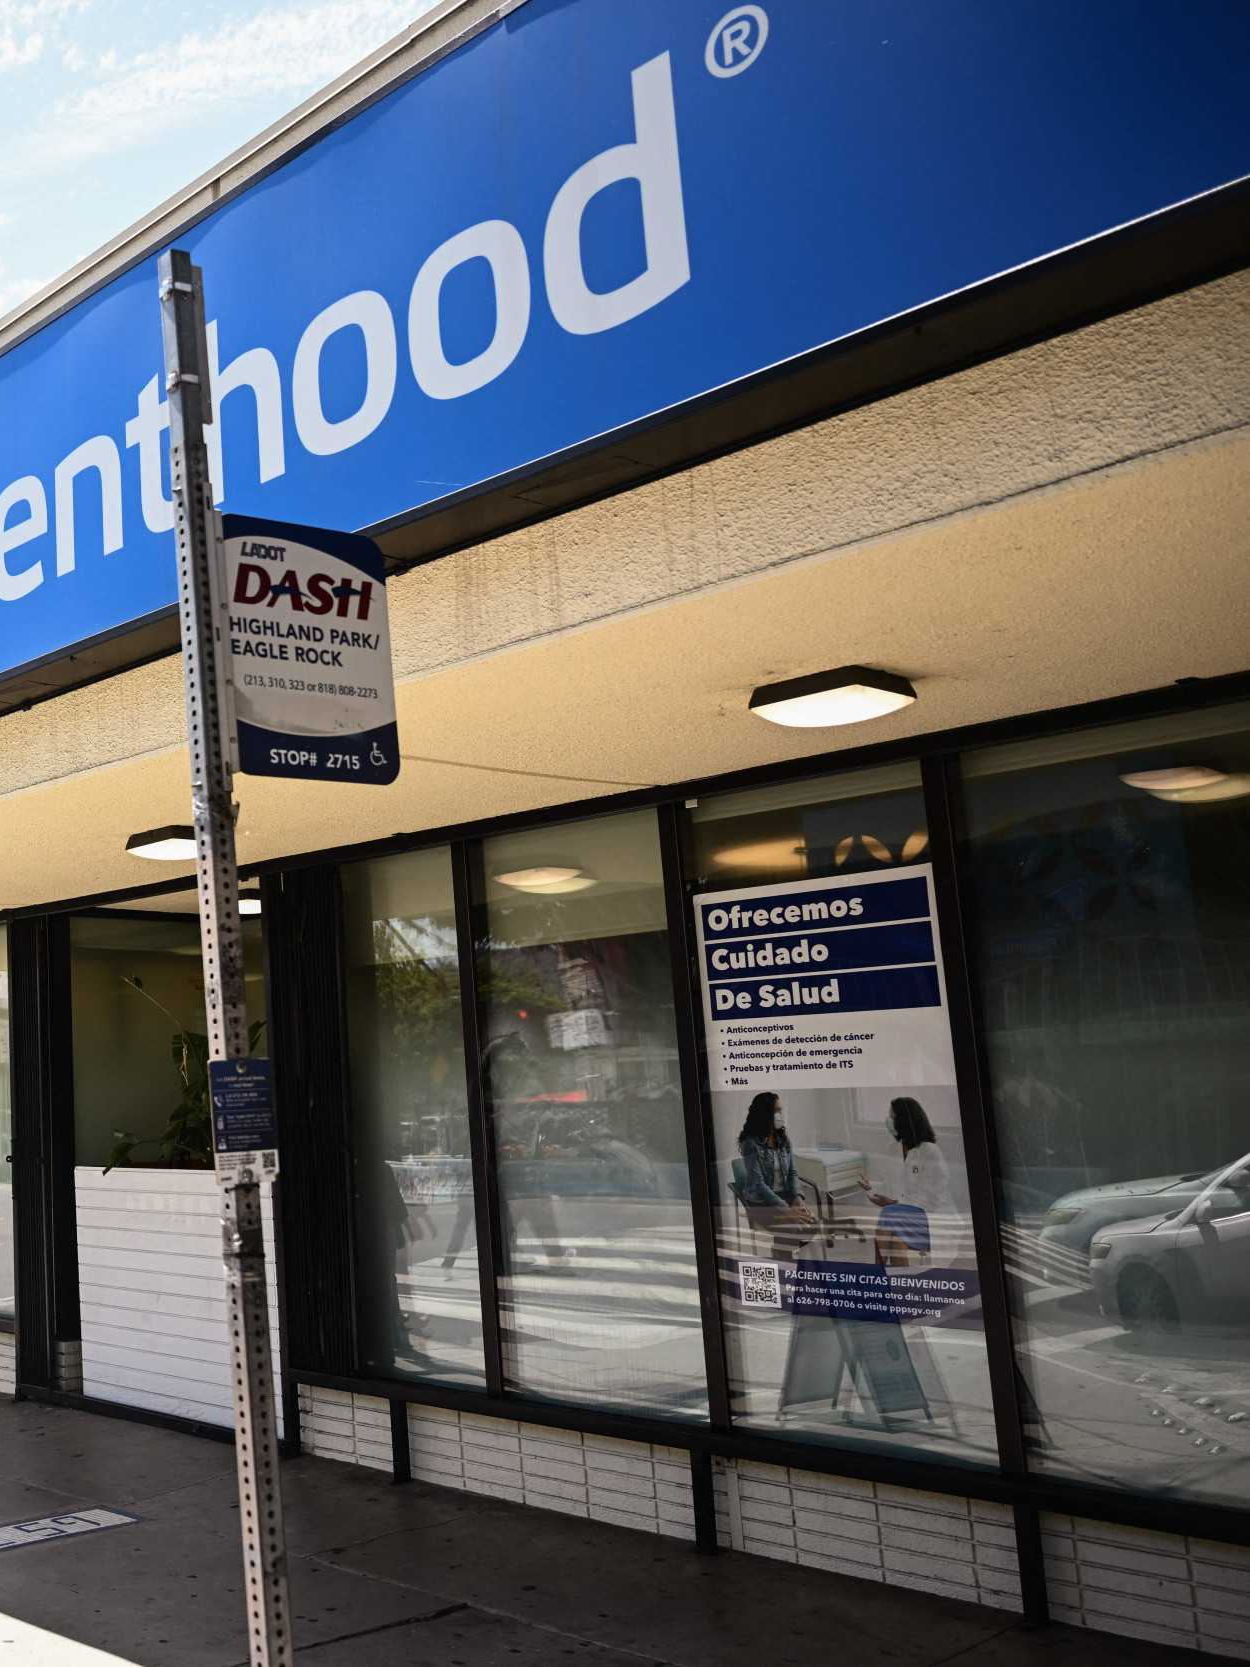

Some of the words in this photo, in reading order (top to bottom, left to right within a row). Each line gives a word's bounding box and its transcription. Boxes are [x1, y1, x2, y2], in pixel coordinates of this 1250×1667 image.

[240, 541, 286, 562] LADOT
[233, 562, 373, 620] DASH
[229, 616, 324, 643] HIGHLAND
[330, 629, 380, 650] PARK/
[231, 639, 289, 661] EAGLE
[295, 647, 343, 667] ROCK
[243, 674, 266, 687] (213,
[268, 677, 287, 690] 310,
[289, 680, 305, 691] 323
[307, 683, 317, 692] or
[318, 683, 337, 696] 818)
[338, 685, 378, 699] 808-2273
[269, 748, 318, 766] STOP#
[326, 754, 361, 770] 2715
[707, 897, 864, 931] Ofrecemos
[711, 939, 829, 971] Cuidado
[714, 988, 752, 1011] De
[758, 978, 841, 1008] Salud
[726, 1023, 794, 1034] Anticonceptivos
[728, 1037, 770, 1047] Exámenes
[772, 1036, 783, 1045] de
[785, 1034, 828, 1044] detección
[830, 1033, 842, 1042] de
[844, 1032, 874, 1041] cáncer
[729, 1049, 794, 1061] Anticoncepción
[796, 1048, 807, 1057] de
[809, 1046, 863, 1058] emergencia
[730, 1063, 763, 1073] Pruebas
[765, 1064, 771, 1073] y
[772, 1061, 824, 1071] tratamiento
[826, 1060, 837, 1069] de
[839, 1060, 854, 1069] ITS
[731, 1077, 748, 1085] Más
[784, 1270, 837, 1282] PACIENTES
[839, 1273, 857, 1284] SIN
[859, 1275, 888, 1286] CITAS
[890, 1277, 965, 1291] BIENVENIDOS
[785, 1284, 804, 1292] Para
[805, 1284, 828, 1294] hacer
[846, 1288, 862, 1297] cita
[863, 1291, 883, 1299] para
[884, 1292, 903, 1300] otro
[796, 1296, 855, 1309] 626-798-0706
[864, 1302, 888, 1311] visite
[890, 1305, 941, 1318] pppsgv.org
